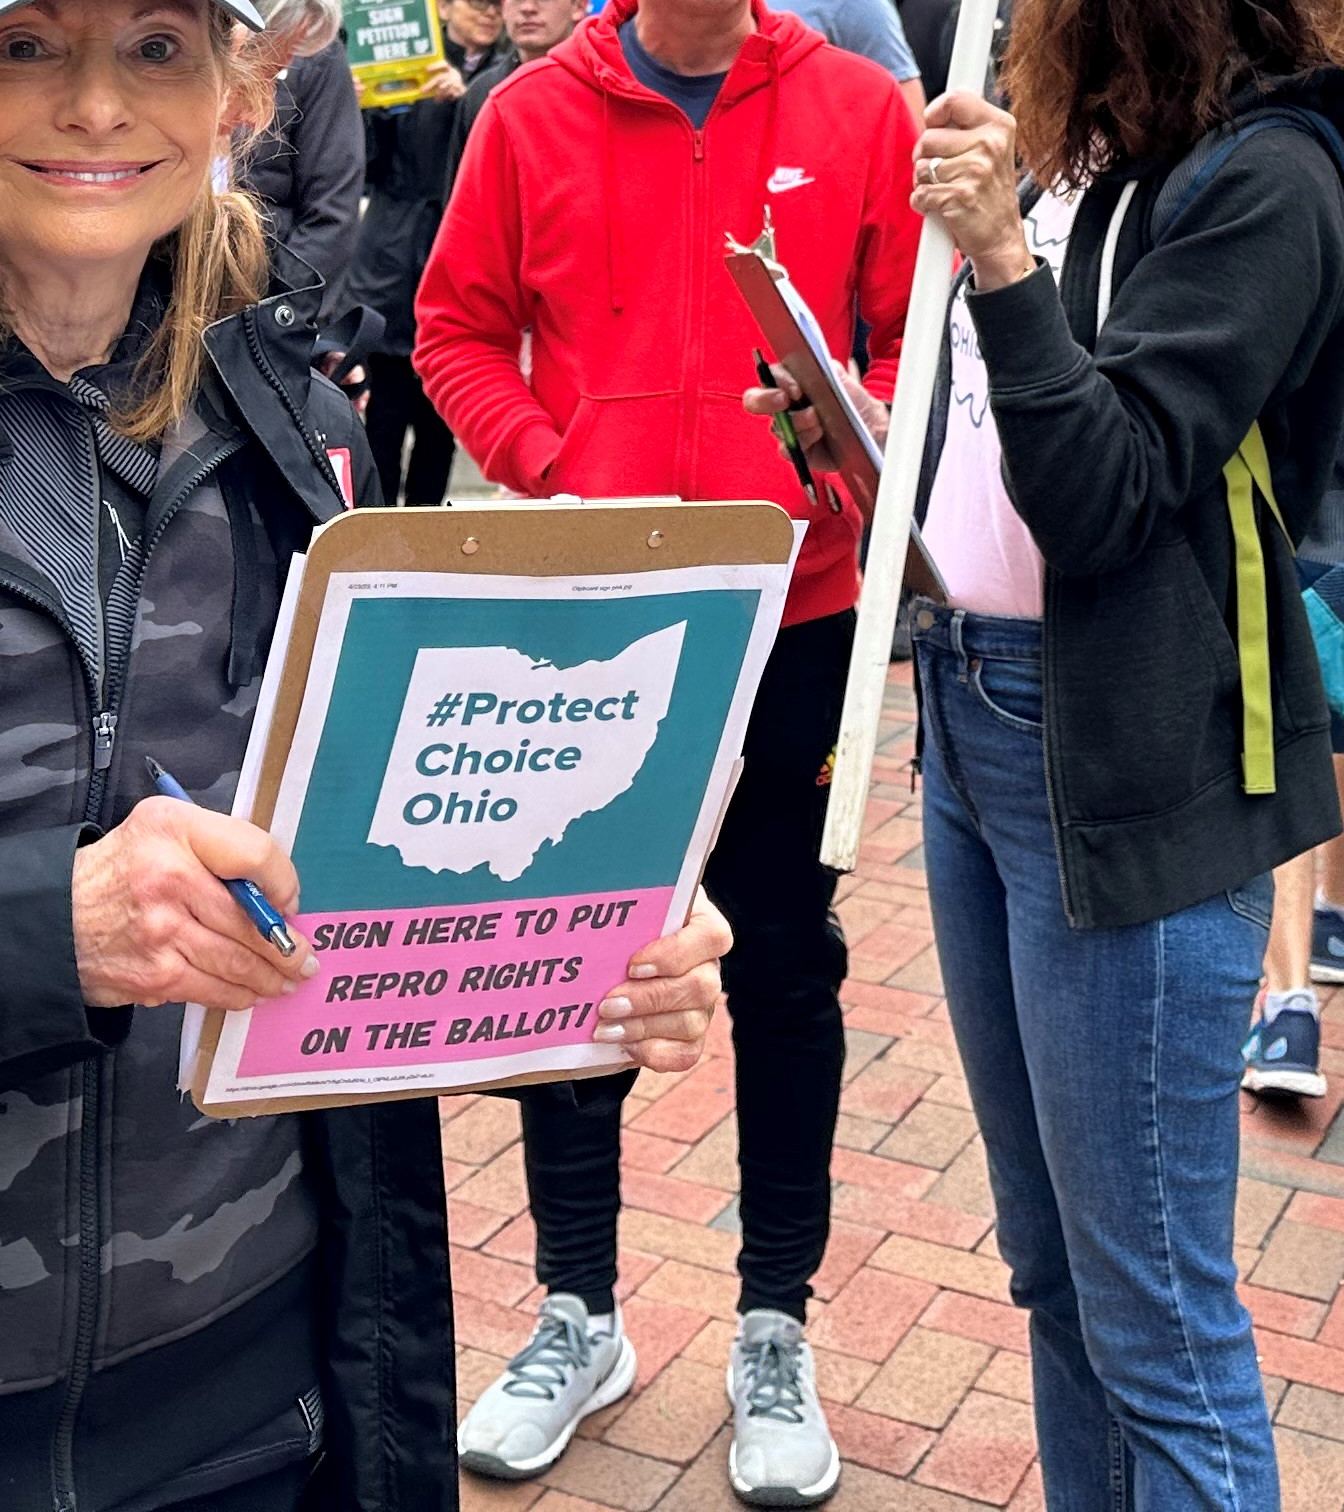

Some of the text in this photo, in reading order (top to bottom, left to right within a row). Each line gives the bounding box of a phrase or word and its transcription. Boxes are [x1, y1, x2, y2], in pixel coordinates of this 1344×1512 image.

[356, 21, 421, 47] PETITION
[367, 7, 404, 25] SIGN
[426, 690, 640, 727] #Protect
[415, 739, 582, 777] Choice
[402, 788, 519, 826] Ohio
[311, 899, 638, 951] SIGN HERE TO PUT
[325, 956, 584, 1003] REPRO RIGHTS
[300, 1002, 594, 1056] ON THE BALLOT!
